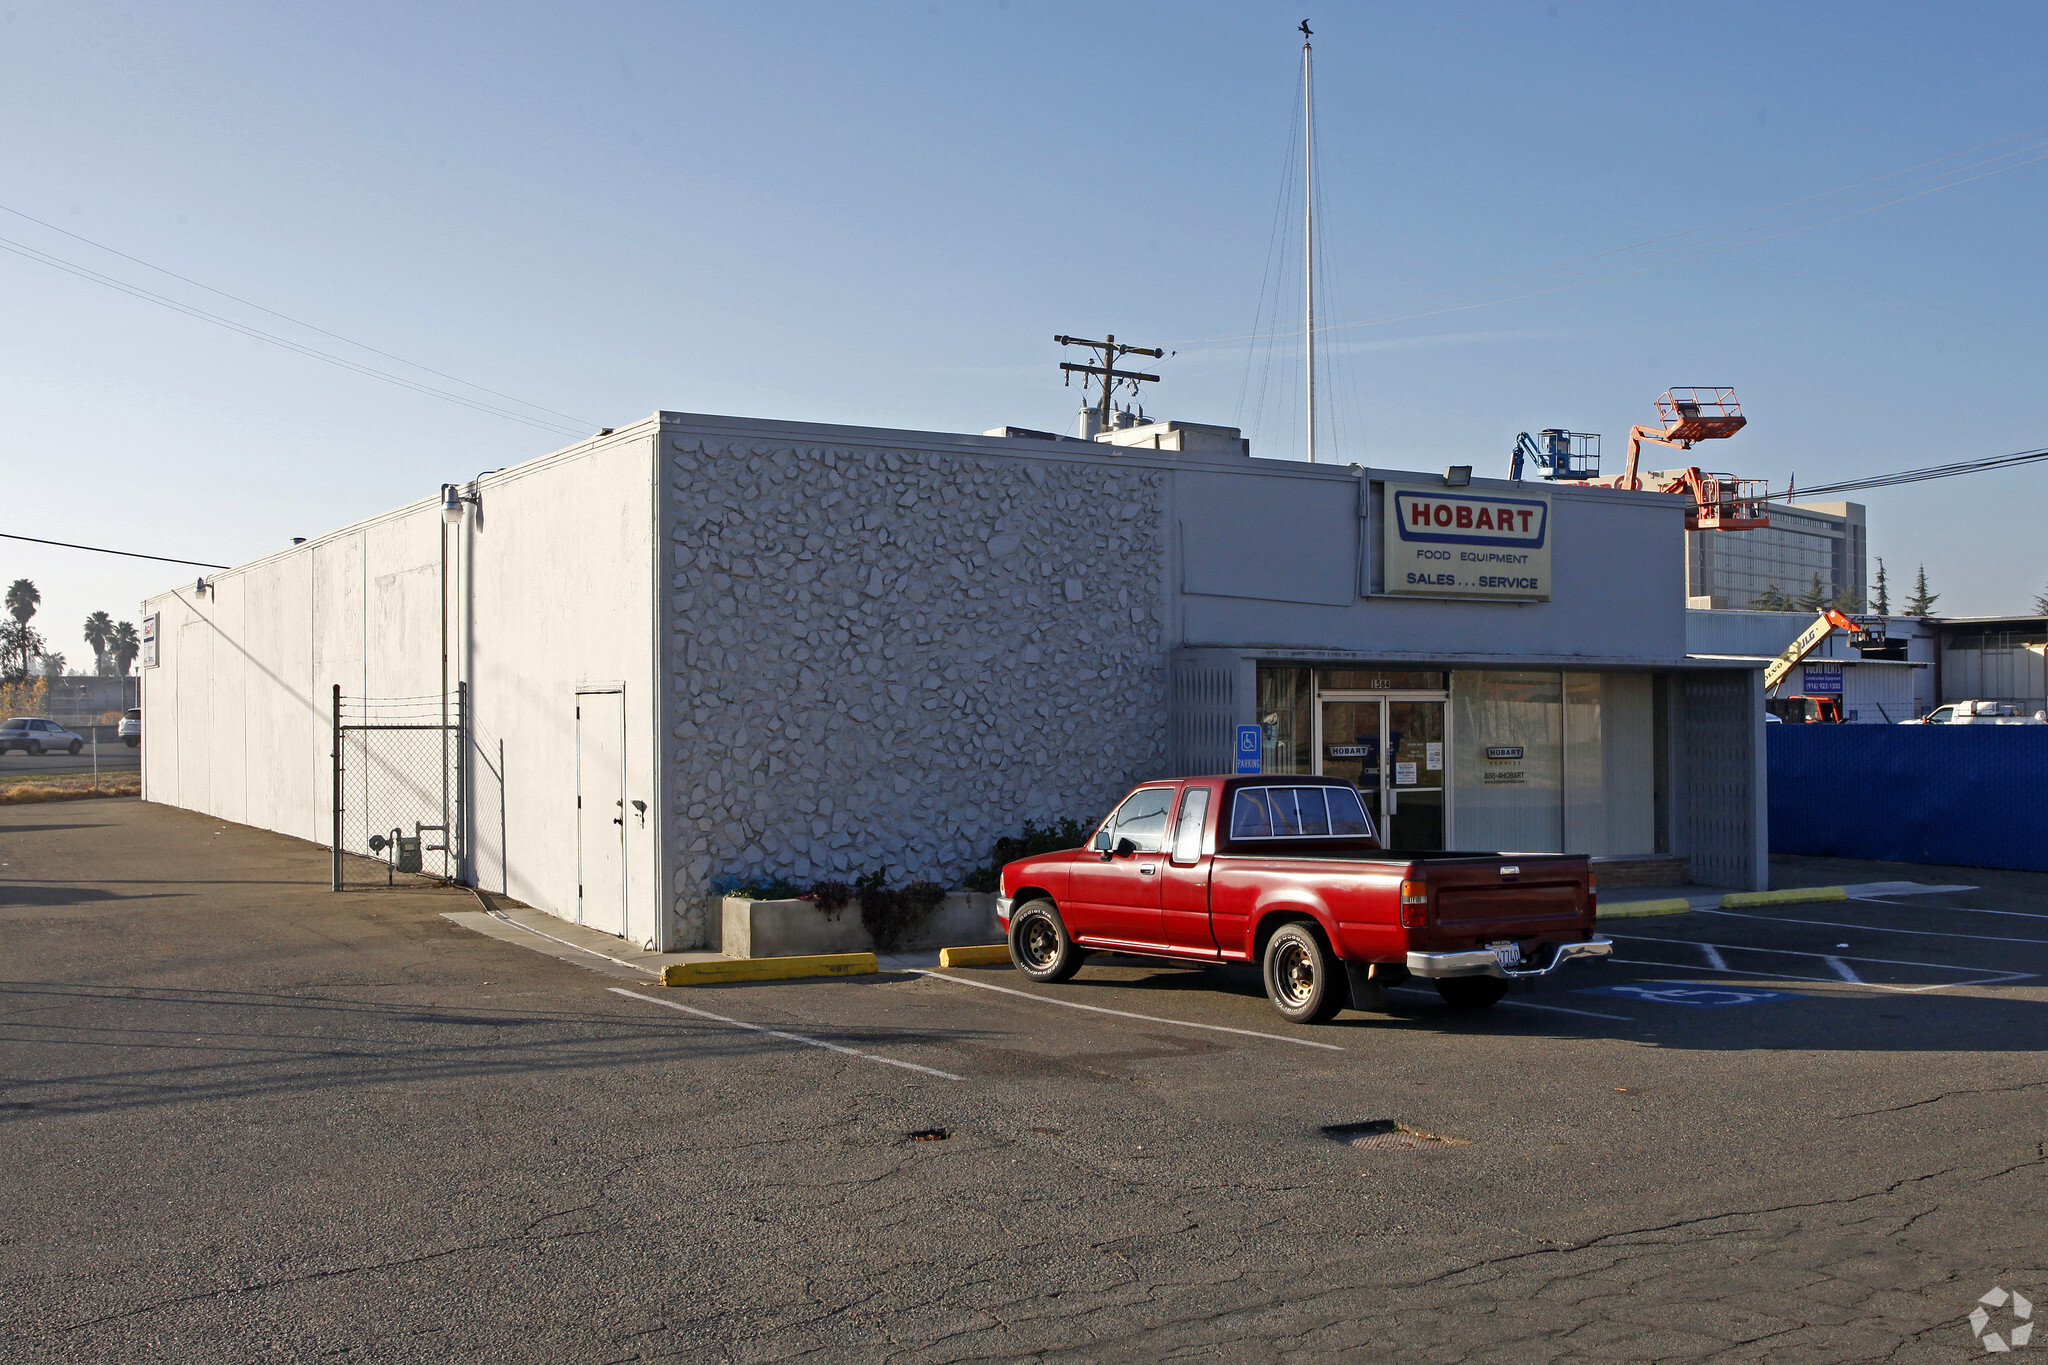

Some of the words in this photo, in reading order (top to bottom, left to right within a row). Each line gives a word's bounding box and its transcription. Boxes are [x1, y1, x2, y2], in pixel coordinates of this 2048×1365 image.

[1411, 502, 1534, 533] HOBART
[1416, 549, 1451, 561] FOOD
[1460, 551, 1529, 565] EQUIPMENT
[1478, 575, 1539, 590] SERVICE
[1801, 629, 1815, 649] JLG
[1371, 680, 1390, 688] 1584
[1332, 747, 1368, 755] HOBART
[1237, 759, 1261, 768] PARKING
